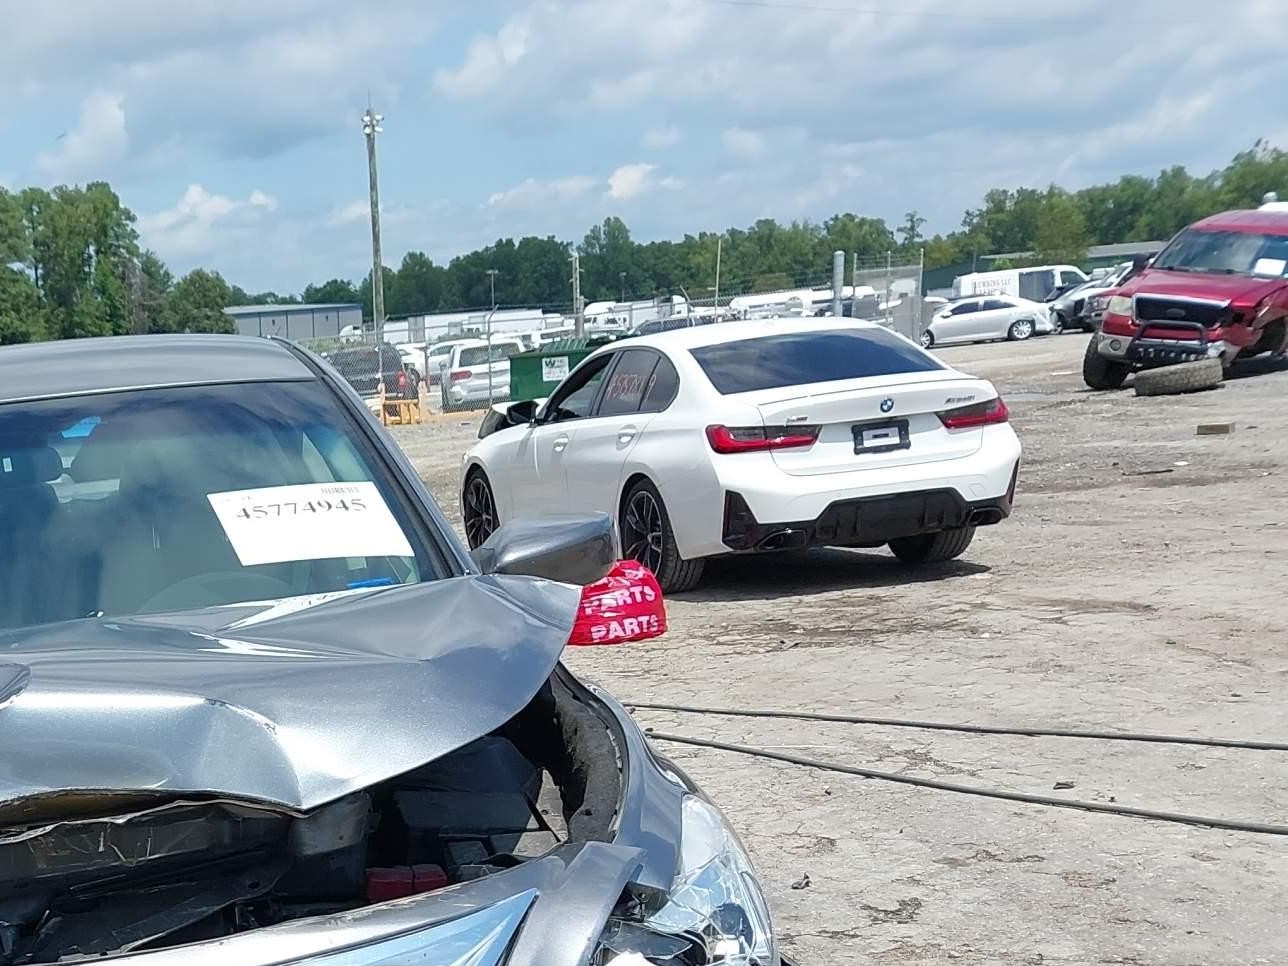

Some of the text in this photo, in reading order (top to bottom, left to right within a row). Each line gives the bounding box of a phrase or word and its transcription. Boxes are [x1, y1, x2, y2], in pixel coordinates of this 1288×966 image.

[236, 499, 367, 519] 45774945
[583, 585, 656, 614] PARTS
[590, 615, 658, 643] PARTS
